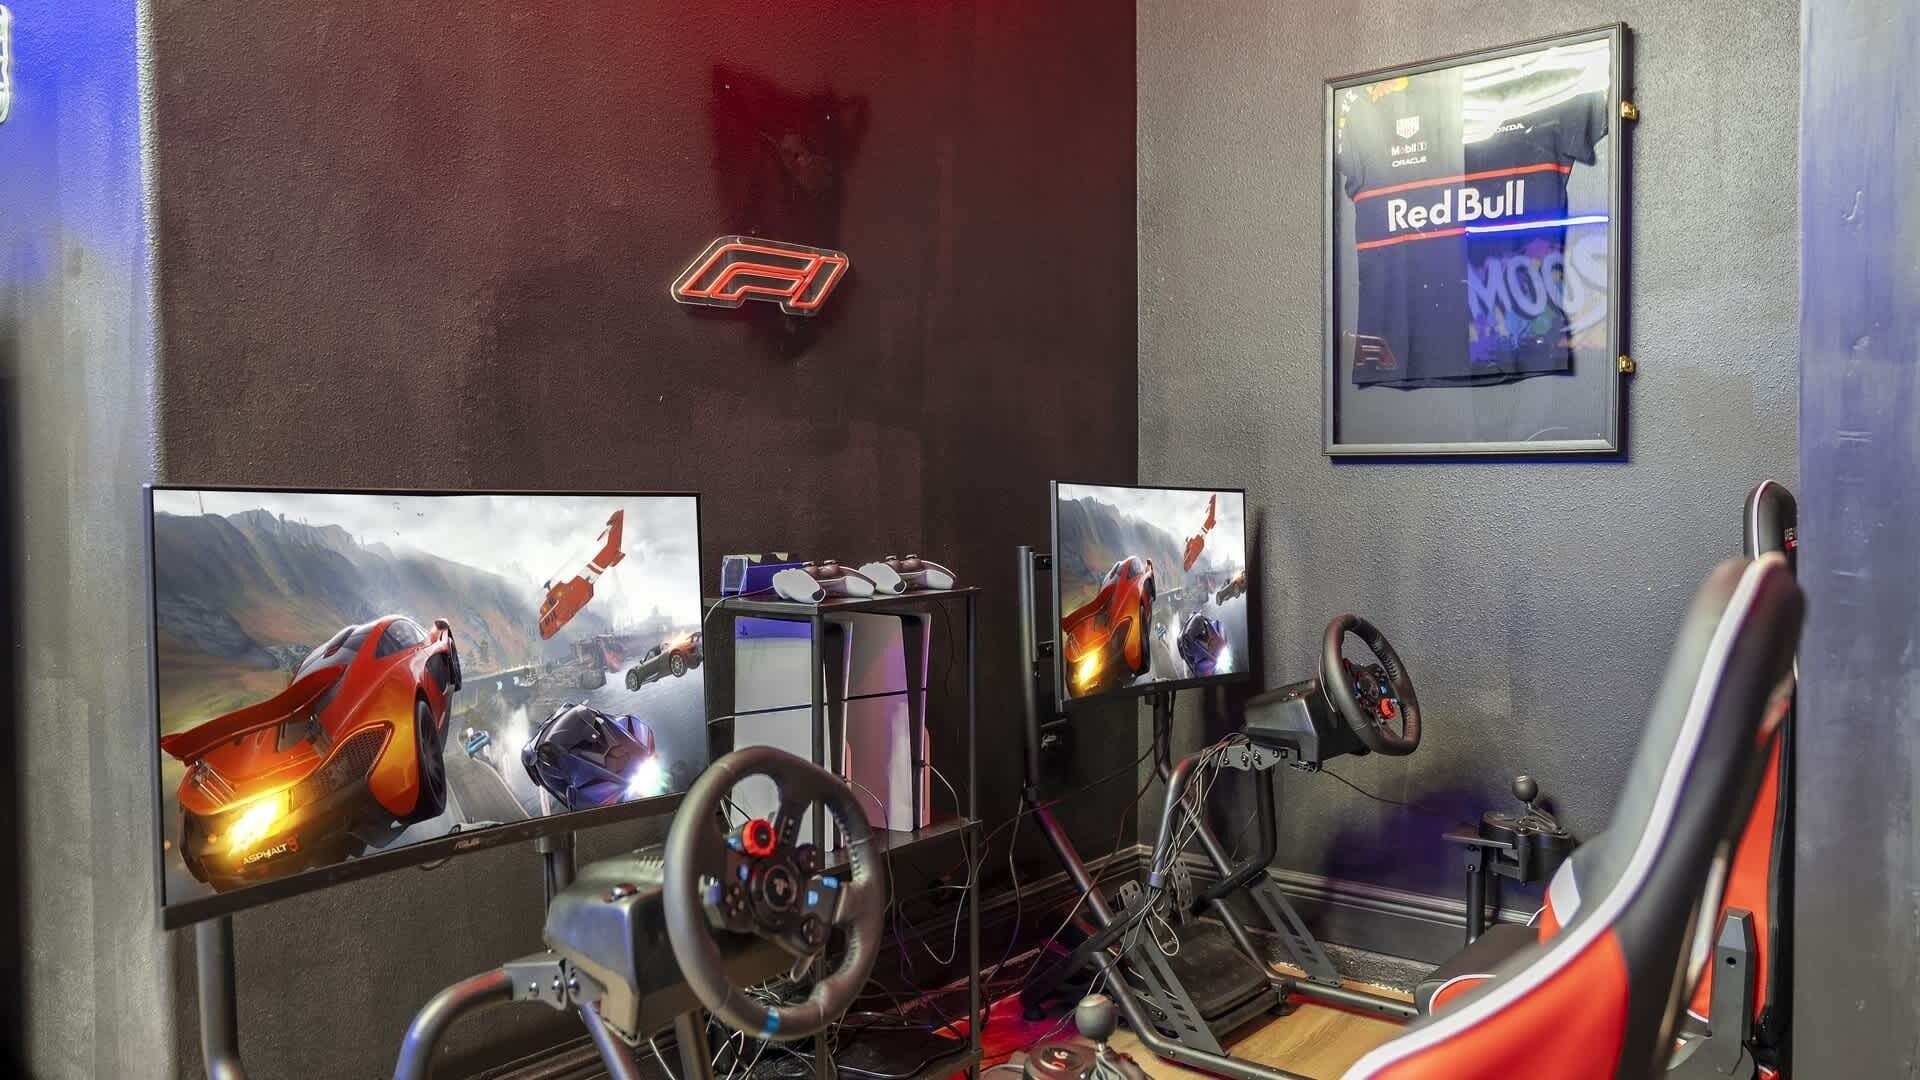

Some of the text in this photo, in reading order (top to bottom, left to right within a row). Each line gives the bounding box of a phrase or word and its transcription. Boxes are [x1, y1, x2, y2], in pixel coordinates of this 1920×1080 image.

[1493, 122, 1525, 134] ONDA
[1391, 143, 1417, 156] Mobil
[1391, 156, 1427, 167] ORACLE
[1387, 179, 1525, 232] Red Bull
[242, 843, 287, 864] ASPHALT
